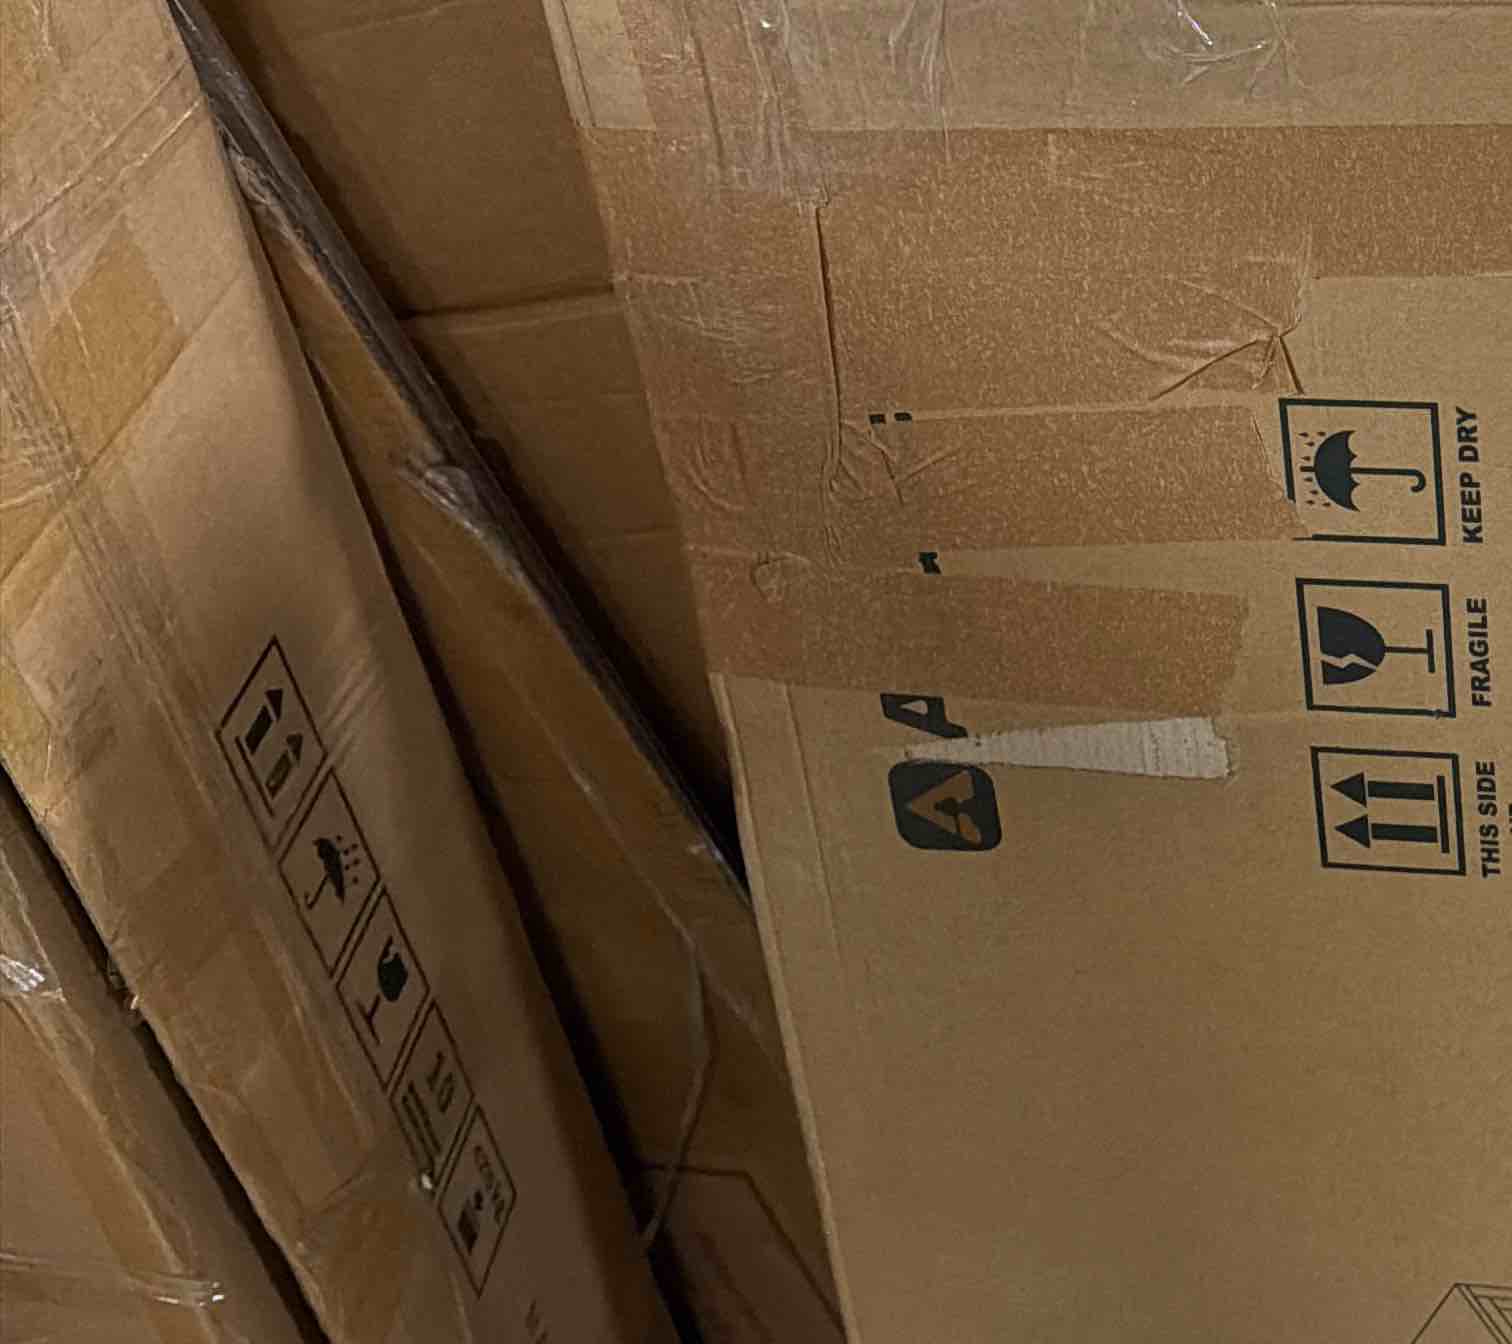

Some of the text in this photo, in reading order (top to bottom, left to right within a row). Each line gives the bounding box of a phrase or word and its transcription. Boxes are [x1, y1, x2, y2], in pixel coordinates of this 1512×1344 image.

[1456, 406, 1483, 544] KEEP DRY
[1466, 597, 1491, 707] FRAGILE
[1475, 761, 1501, 878] THIS SIDE
